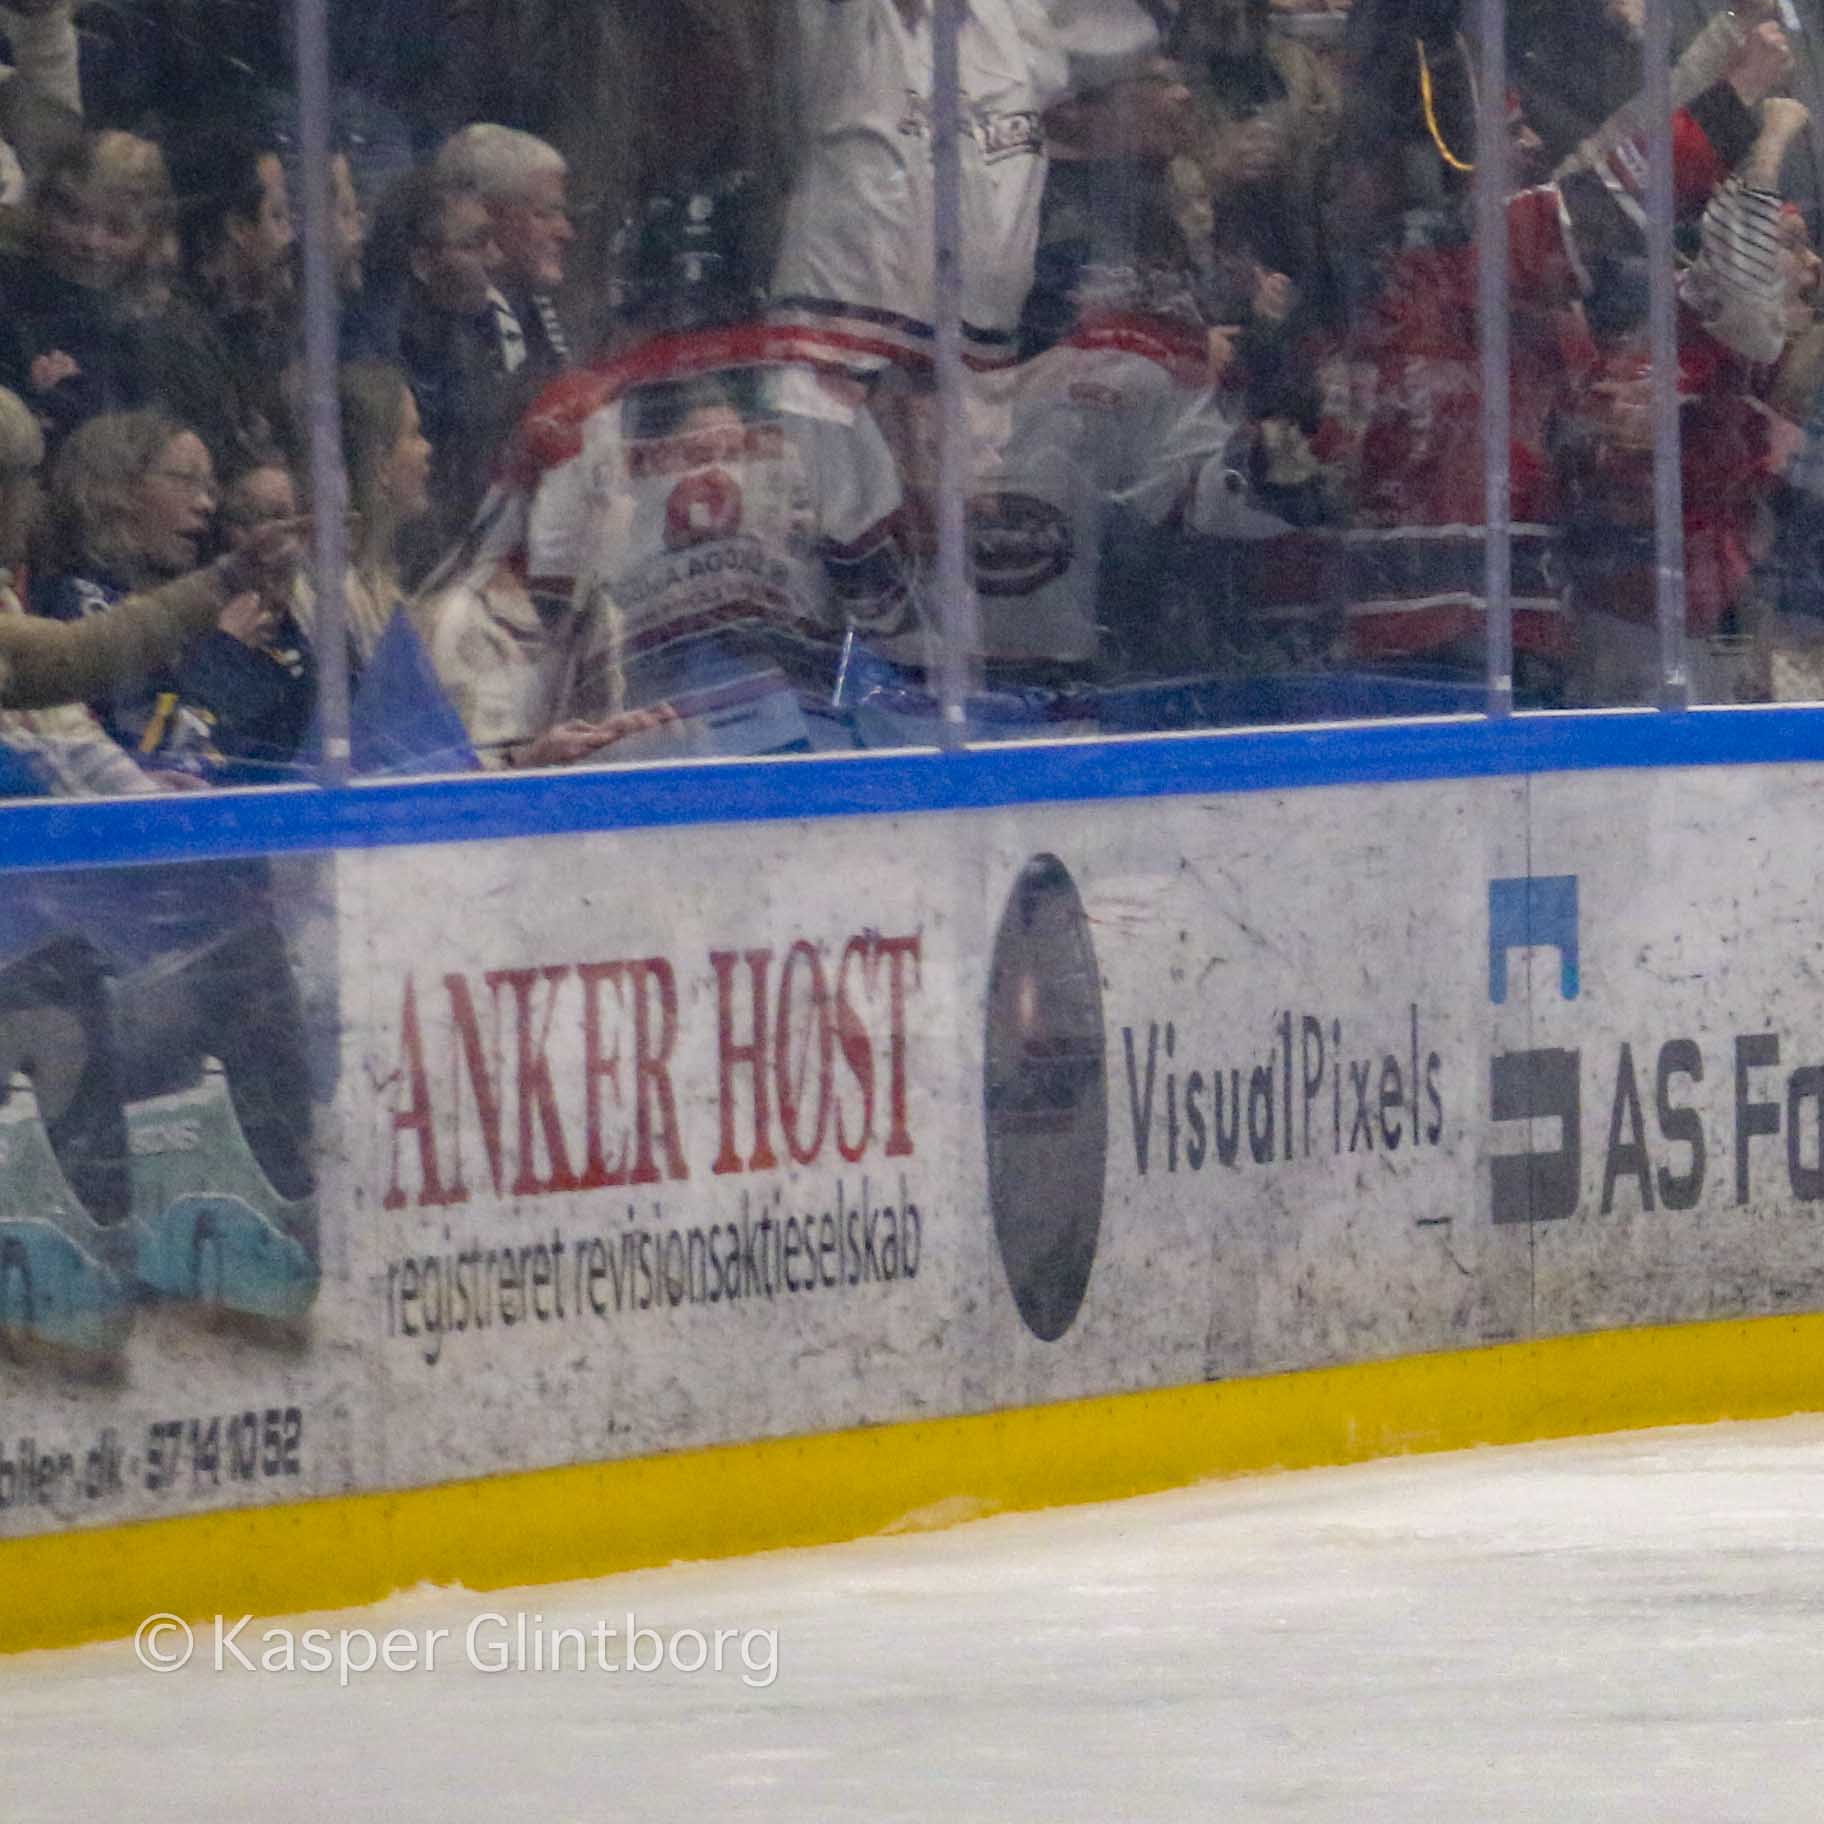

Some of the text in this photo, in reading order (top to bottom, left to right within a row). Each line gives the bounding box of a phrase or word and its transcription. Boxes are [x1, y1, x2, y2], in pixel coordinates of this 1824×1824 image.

[383, 934, 926, 1209] ANKER HØST
[1599, 1038, 1709, 1215] AS
[386, 1180, 924, 1364] registreret revisionsaktieselskab
